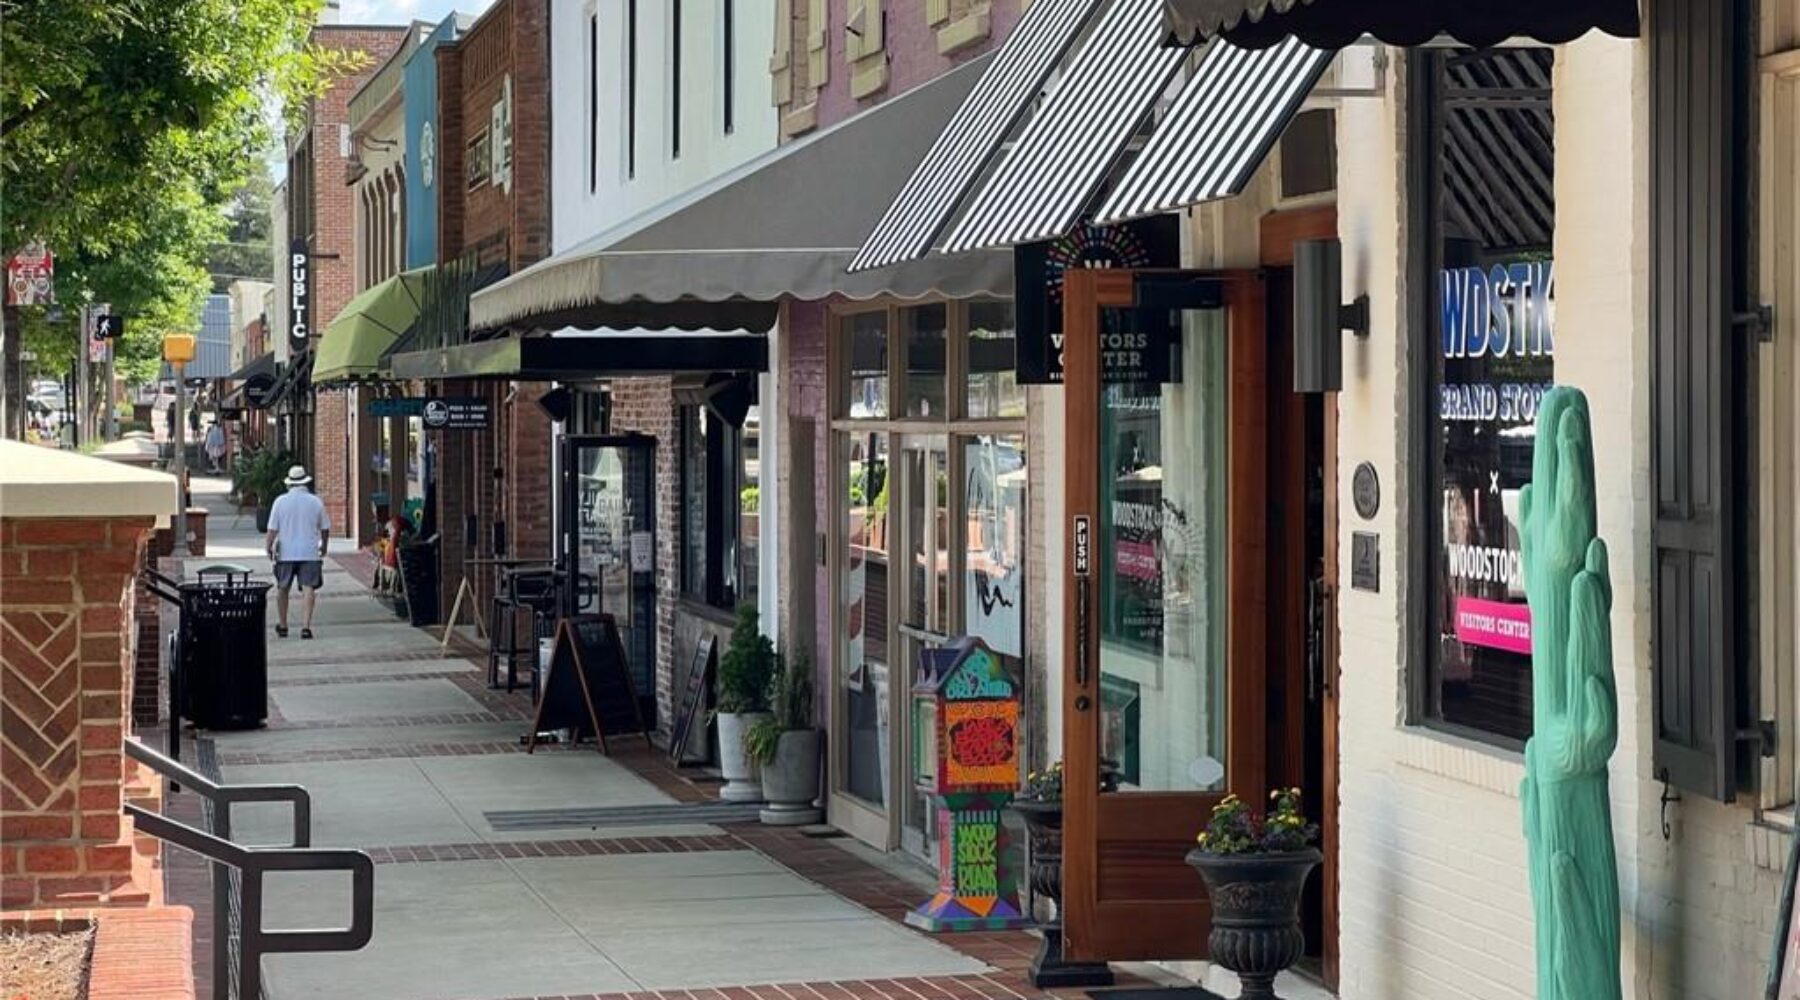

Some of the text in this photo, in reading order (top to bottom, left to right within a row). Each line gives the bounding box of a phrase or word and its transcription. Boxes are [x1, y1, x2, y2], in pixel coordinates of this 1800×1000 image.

[293, 254, 306, 338] PUBLIC
[1440, 261, 1555, 358] WDSTK
[1050, 333, 1147, 349] VTORS
[1439, 382, 1553, 421] BRAND STOR
[1077, 521, 1086, 569] PUSH
[1459, 611, 1531, 640] VISITORS CENTER
